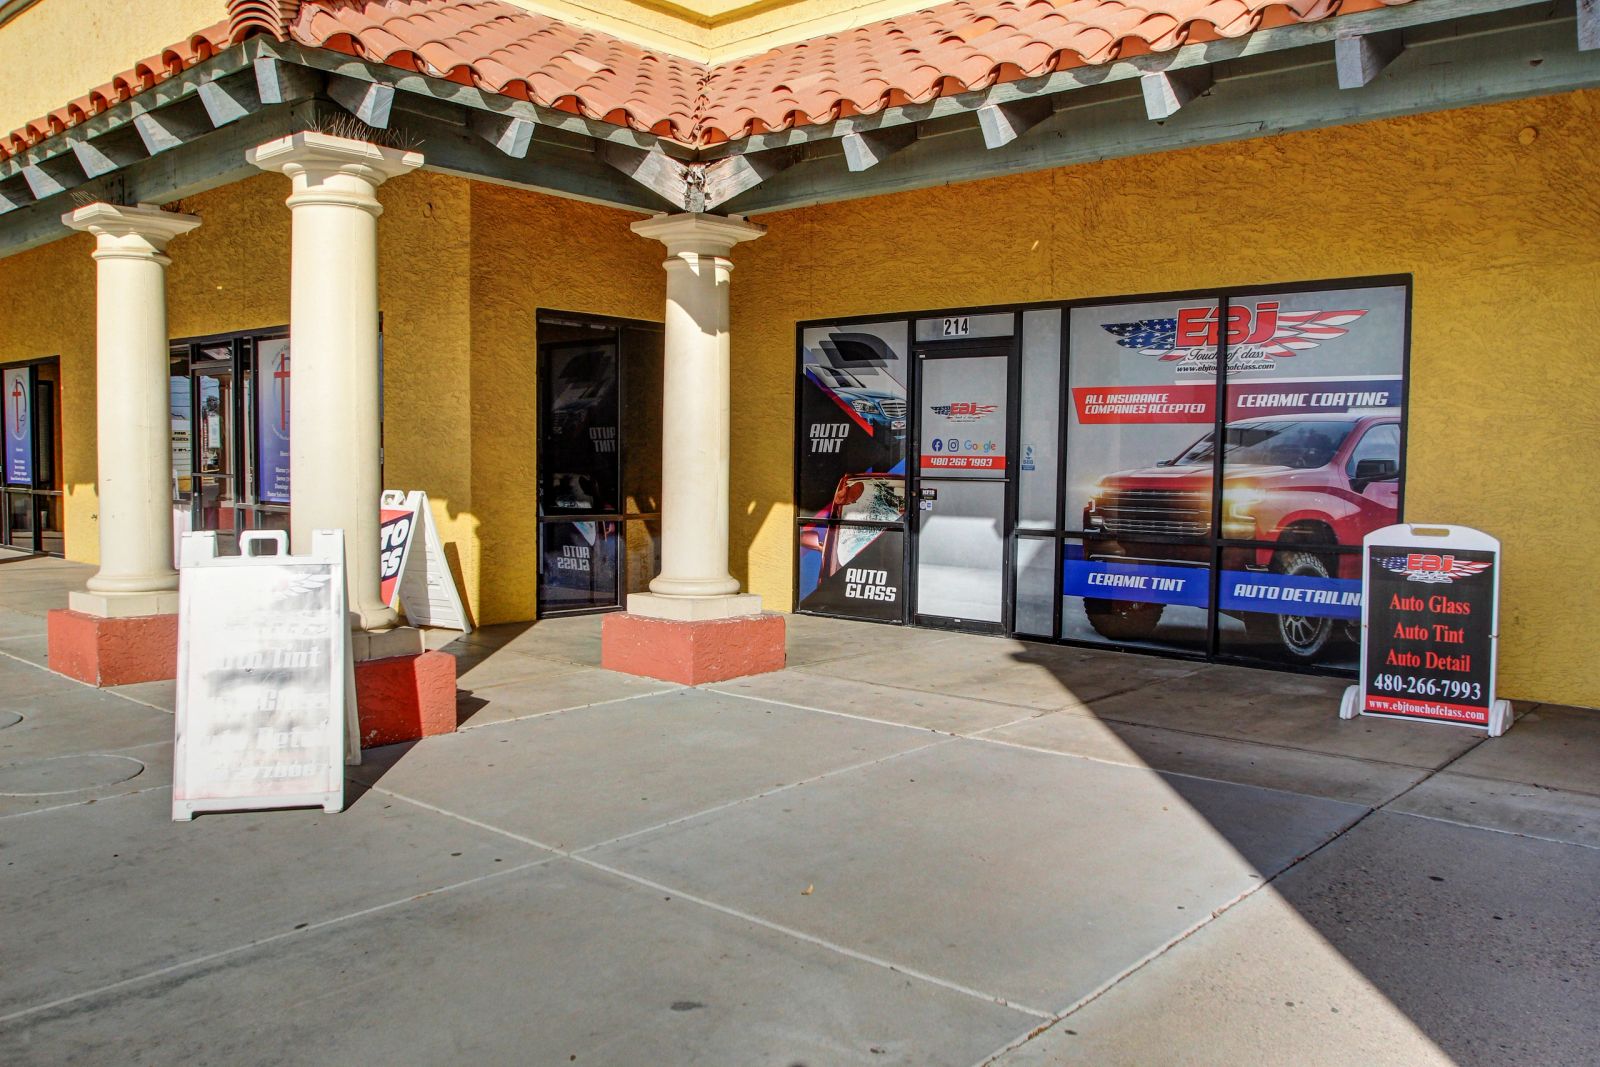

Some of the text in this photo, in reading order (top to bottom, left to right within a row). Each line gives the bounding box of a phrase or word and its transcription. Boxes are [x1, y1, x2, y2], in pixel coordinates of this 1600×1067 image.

[944, 318, 969, 336] 214
[1226, 347, 1242, 362] of
[1241, 348, 1265, 360] class
[1085, 393, 1168, 404] ALL INSURANCE
[1237, 391, 1388, 408] CERAMIC COATING
[1085, 403, 1205, 414] COMPANIES ACCEPTED
[810, 423, 849, 438] AUTO
[810, 439, 843, 453] TINT
[964, 439, 997, 453] Google
[931, 457, 993, 467] 480 266 7993
[845, 568, 887, 585] AUTO
[1087, 572, 1186, 592] CERAMIC TINT
[845, 583, 896, 602] GLASS
[1234, 583, 1363, 605] AUTO DETAILIN
[1389, 592, 1471, 615] Auto Glass
[1394, 622, 1465, 644] Auto Tint
[1386, 649, 1471, 672] Auto Detail
[1374, 673, 1481, 700] 480-266-7993
[1369, 699, 1485, 721] www.ebjtouchofclass.com
